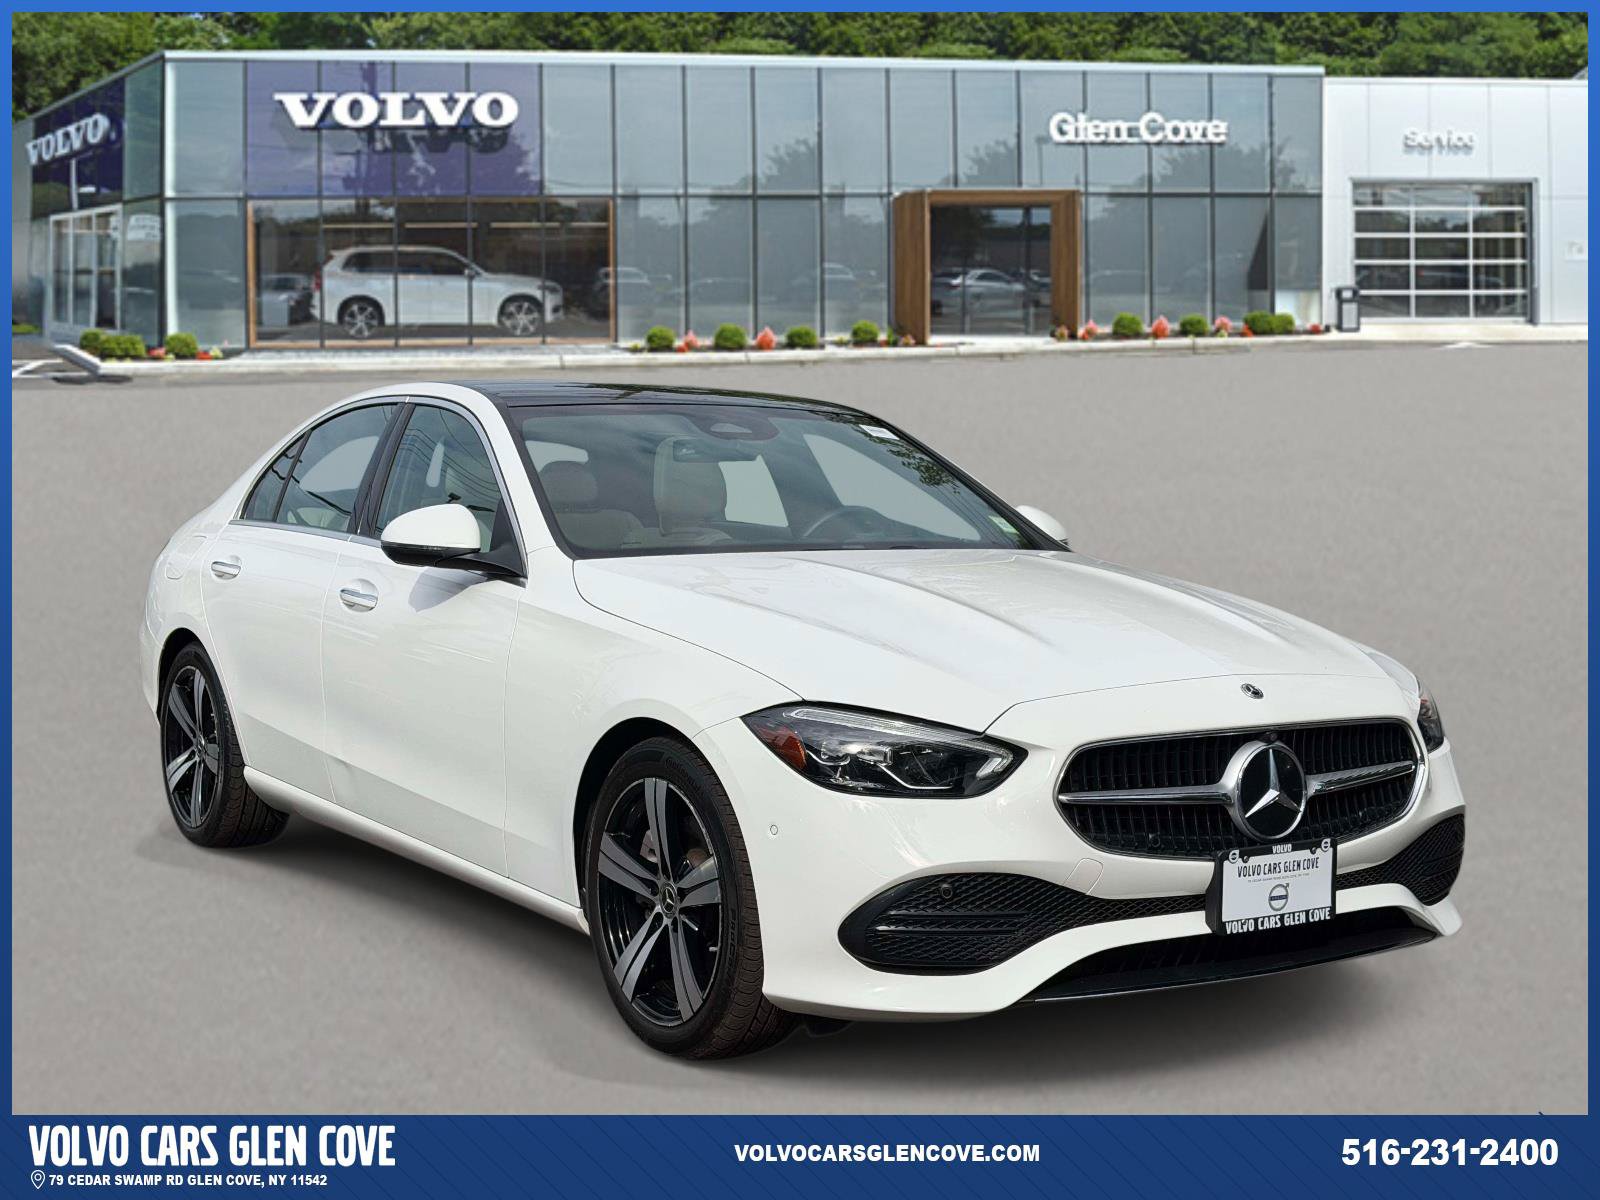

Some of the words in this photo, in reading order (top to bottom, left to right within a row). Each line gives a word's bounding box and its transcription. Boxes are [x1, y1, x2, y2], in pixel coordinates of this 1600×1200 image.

[275, 92, 519, 128] VOLVO
[25, 112, 110, 165] VOLVO
[1050, 111, 1130, 143] Glen
[1139, 111, 1228, 143] Cove
[1402, 127, 1476, 152] Service
[1272, 844, 1292, 854] VOLVO
[1238, 864, 1261, 878] VOLVO
[1263, 862, 1282, 875] CARS
[1284, 859, 1301, 873] GLEN
[1303, 857, 1320, 870] COVE
[1225, 919, 1254, 934] VOLVO
[1258, 916, 1281, 930] CARS
[1284, 911, 1306, 926] GLEN
[1309, 907, 1331, 922] COVE
